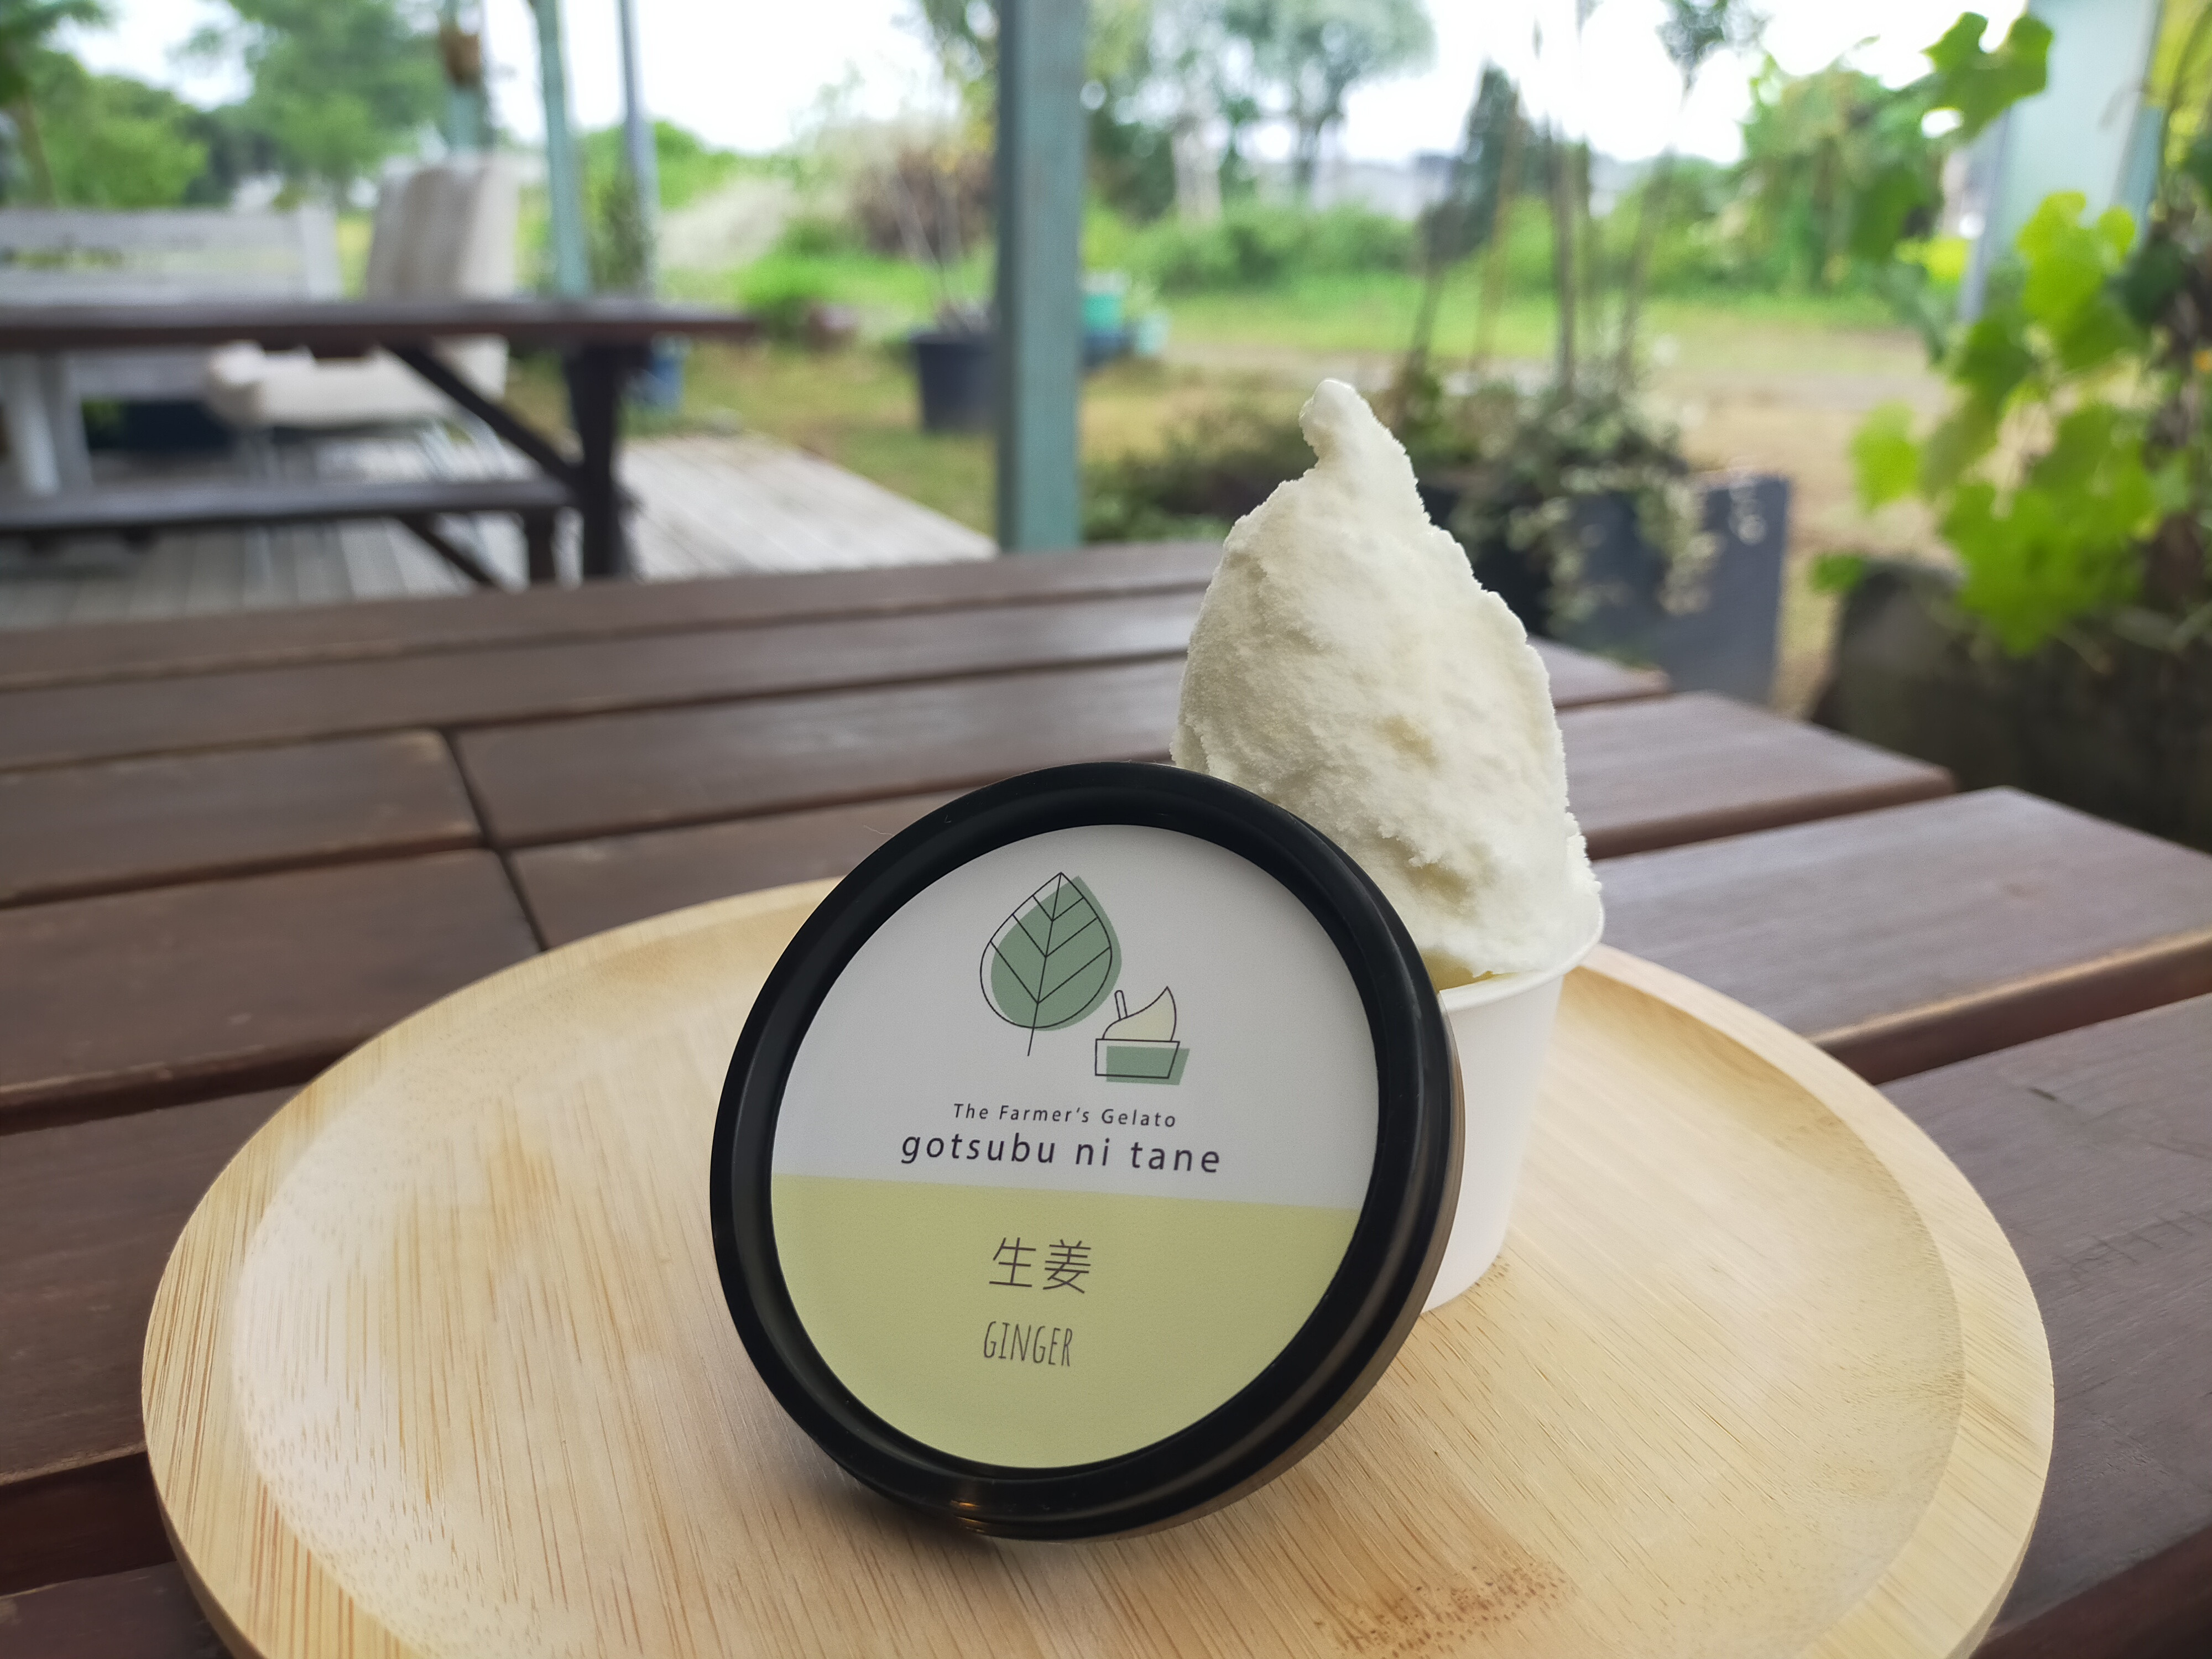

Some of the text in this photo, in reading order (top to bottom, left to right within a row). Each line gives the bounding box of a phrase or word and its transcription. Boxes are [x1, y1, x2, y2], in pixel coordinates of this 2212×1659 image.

[953, 1103, 1176, 1128] The Farmer's Gelato
[901, 1132, 1220, 1173] gotsubu ni tane
[988, 1237, 1092, 1294] 生姜
[983, 1321, 1073, 1367] GINGER
